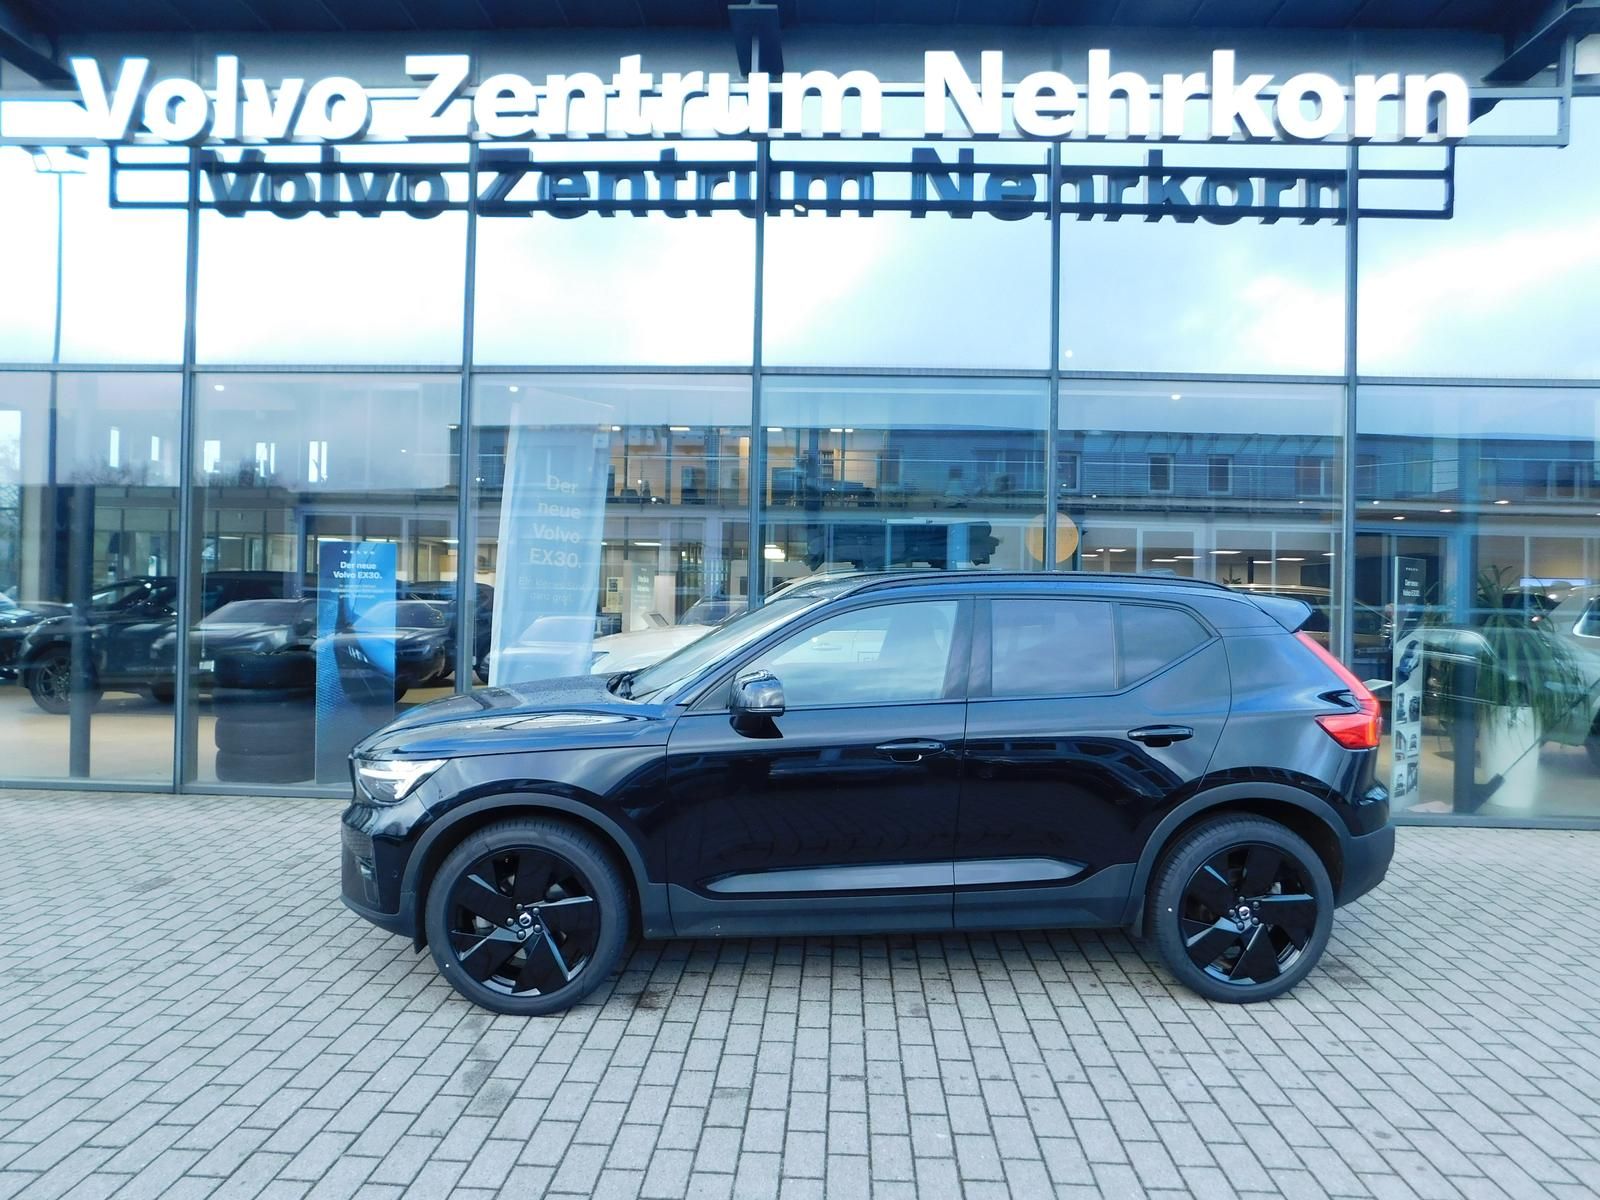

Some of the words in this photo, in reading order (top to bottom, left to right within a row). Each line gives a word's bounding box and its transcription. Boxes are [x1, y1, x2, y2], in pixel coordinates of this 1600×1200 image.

[70, 54, 372, 141] Volvo
[404, 53, 881, 138] Zentrum
[923, 48, 1471, 141] Nehrkorn
[200, 144, 450, 219] Volvo
[546, 474, 579, 494] Der
[537, 501, 583, 520] neue
[532, 523, 581, 544] Volvo
[528, 548, 582, 569] EX30.
[332, 570, 356, 579] Volvo
